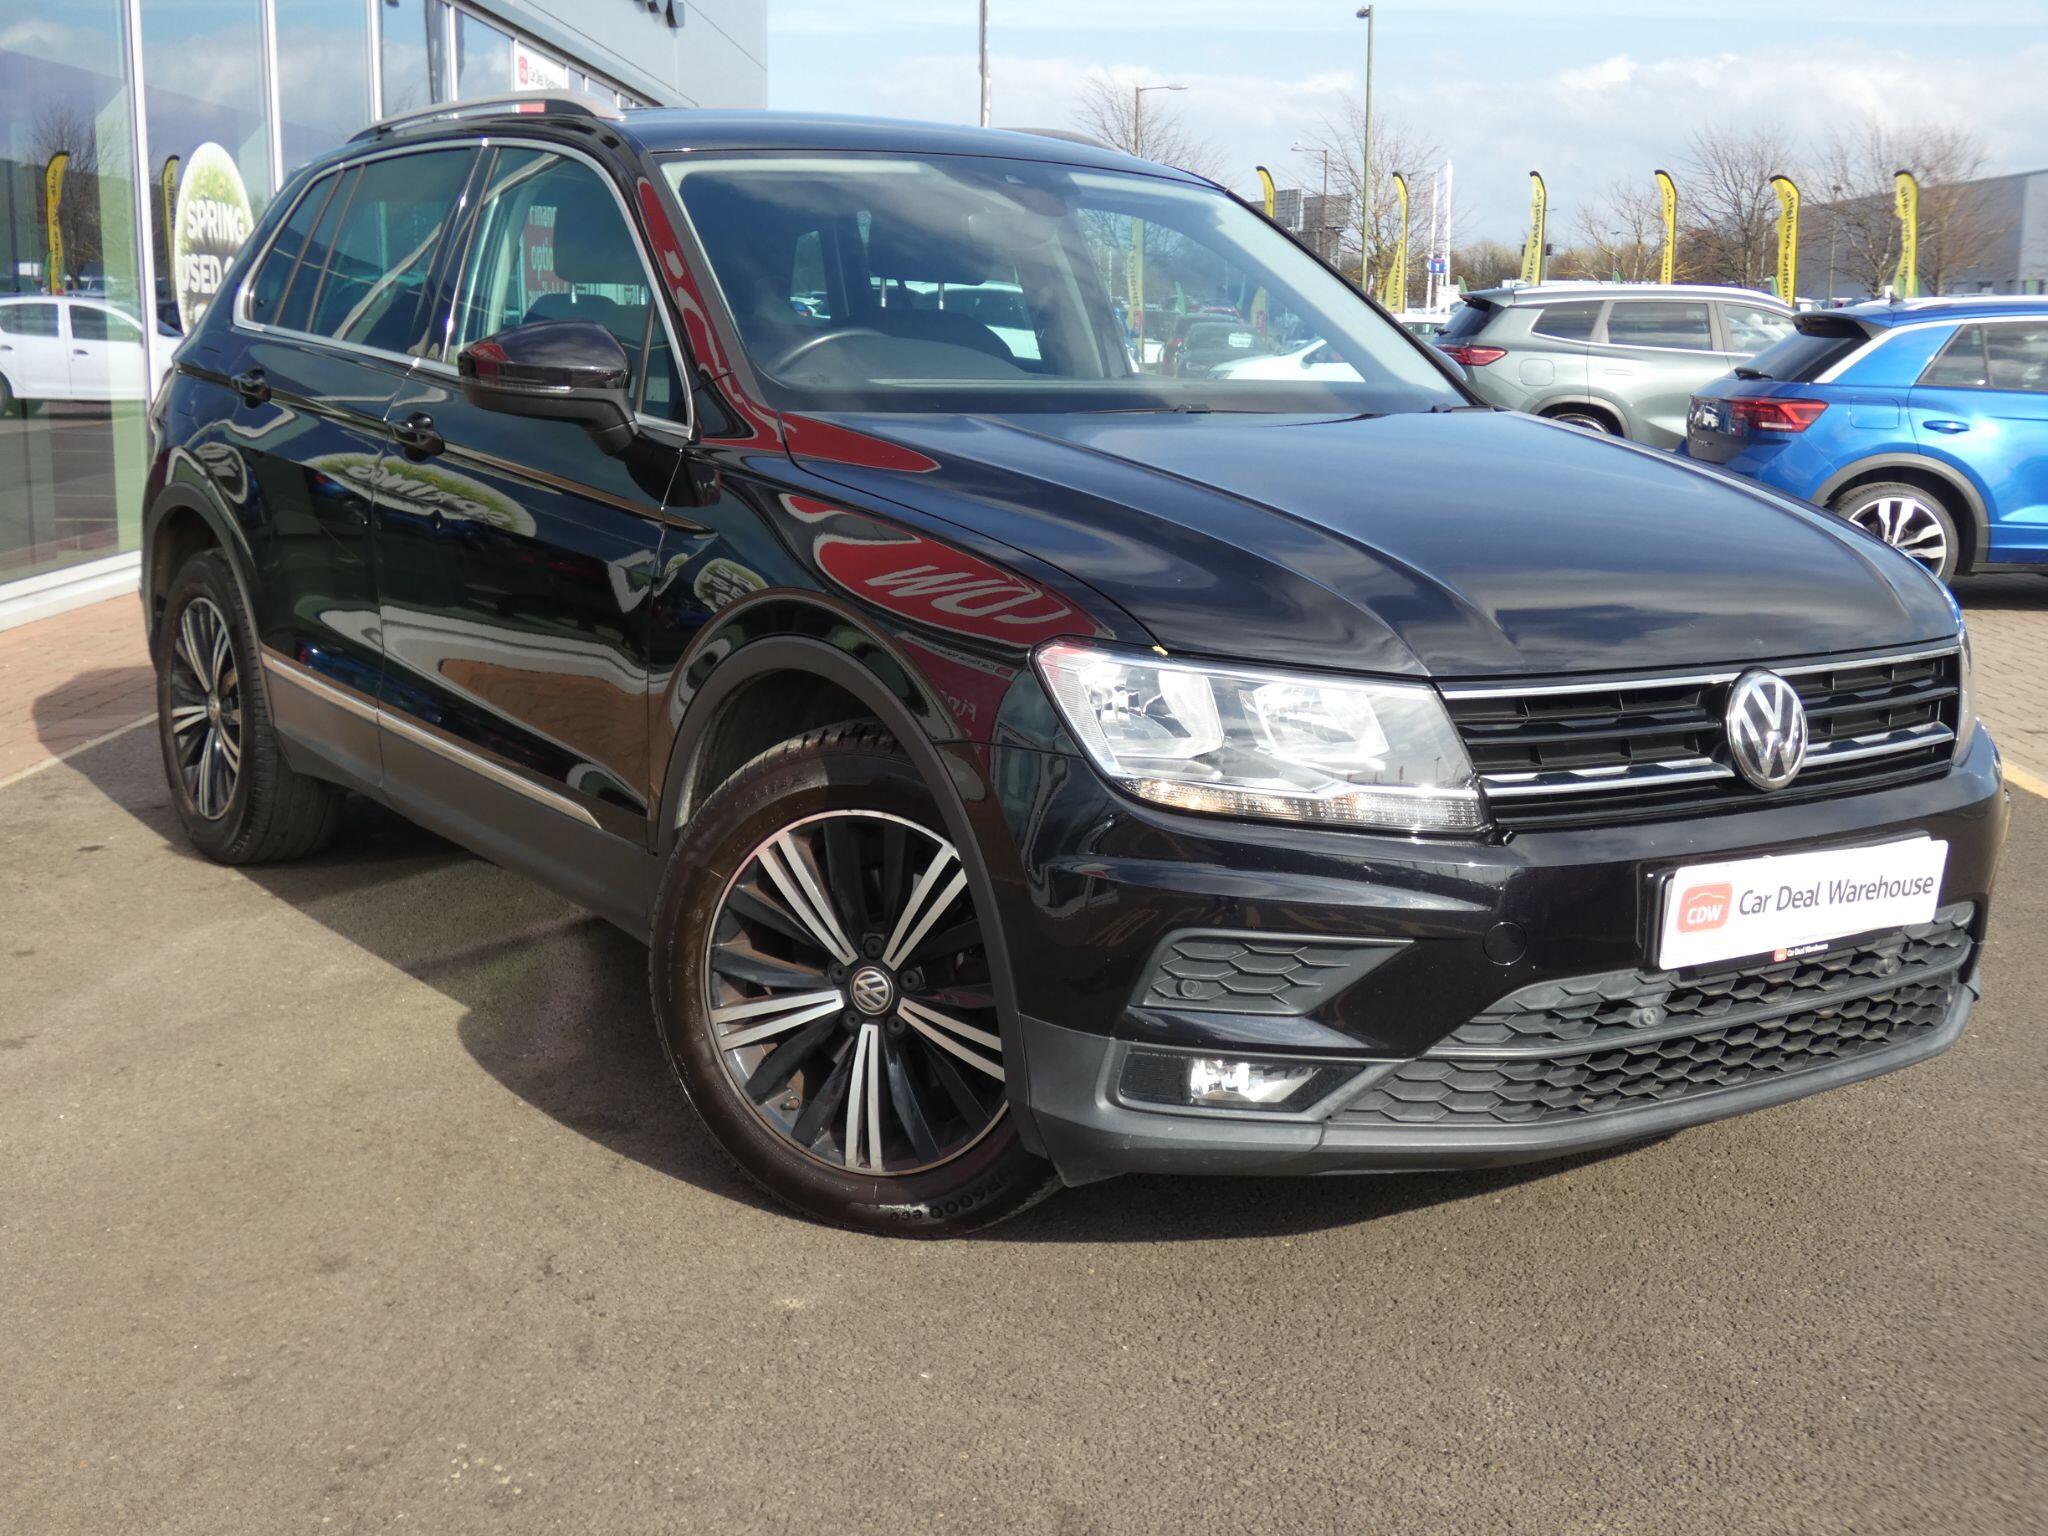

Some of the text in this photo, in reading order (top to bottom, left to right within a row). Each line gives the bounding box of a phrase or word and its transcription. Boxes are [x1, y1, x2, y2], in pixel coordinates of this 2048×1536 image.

[186, 199, 244, 241] SPRING
[1686, 903, 1723, 925] CDW
[1738, 874, 1935, 916] Car Deal Warehouse
